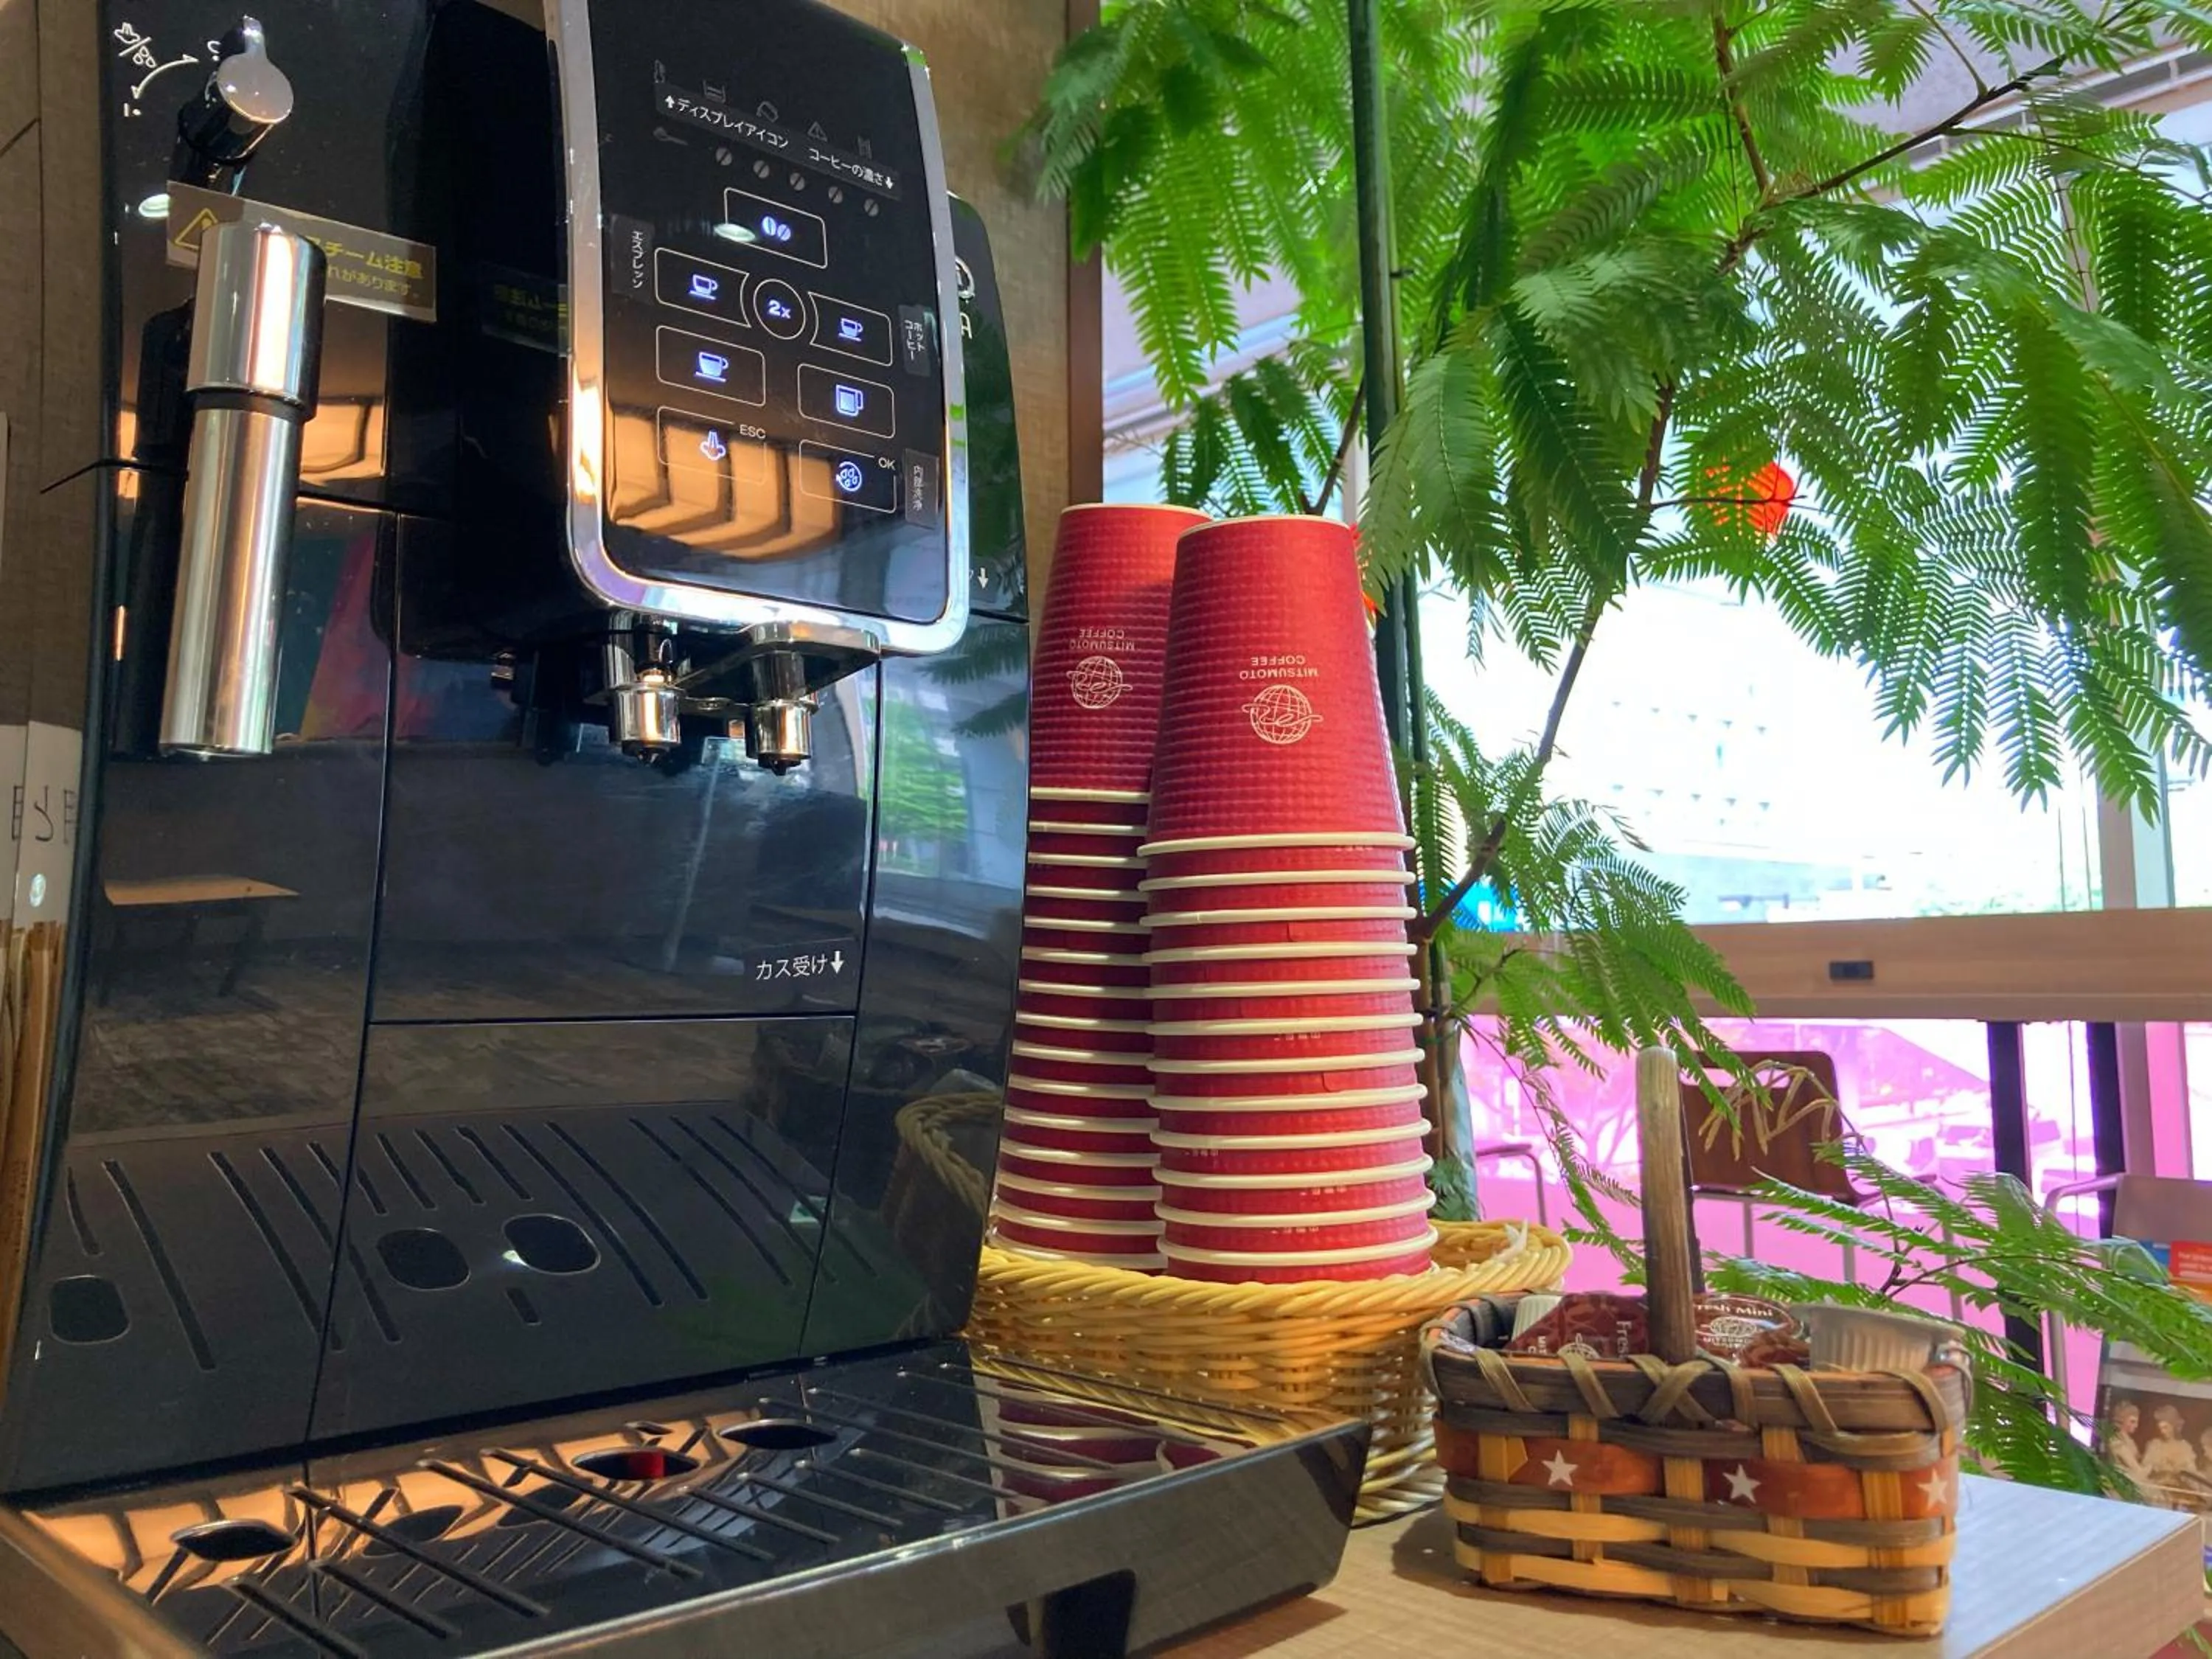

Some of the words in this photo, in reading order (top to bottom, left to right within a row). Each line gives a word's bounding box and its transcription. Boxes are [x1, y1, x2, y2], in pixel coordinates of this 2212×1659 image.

[768, 299, 791, 319] 2x
[740, 424, 767, 439] ESC
[878, 457, 896, 471] OK
[1079, 627, 1124, 639] COFFEE
[1069, 639, 1135, 652] MITSUMOTO
[1250, 655, 1306, 667] COFFEE
[1239, 667, 1318, 681] MITSUMOTO
[755, 954, 829, 981] カス受け
[1736, 1307, 1773, 1317] Mini
